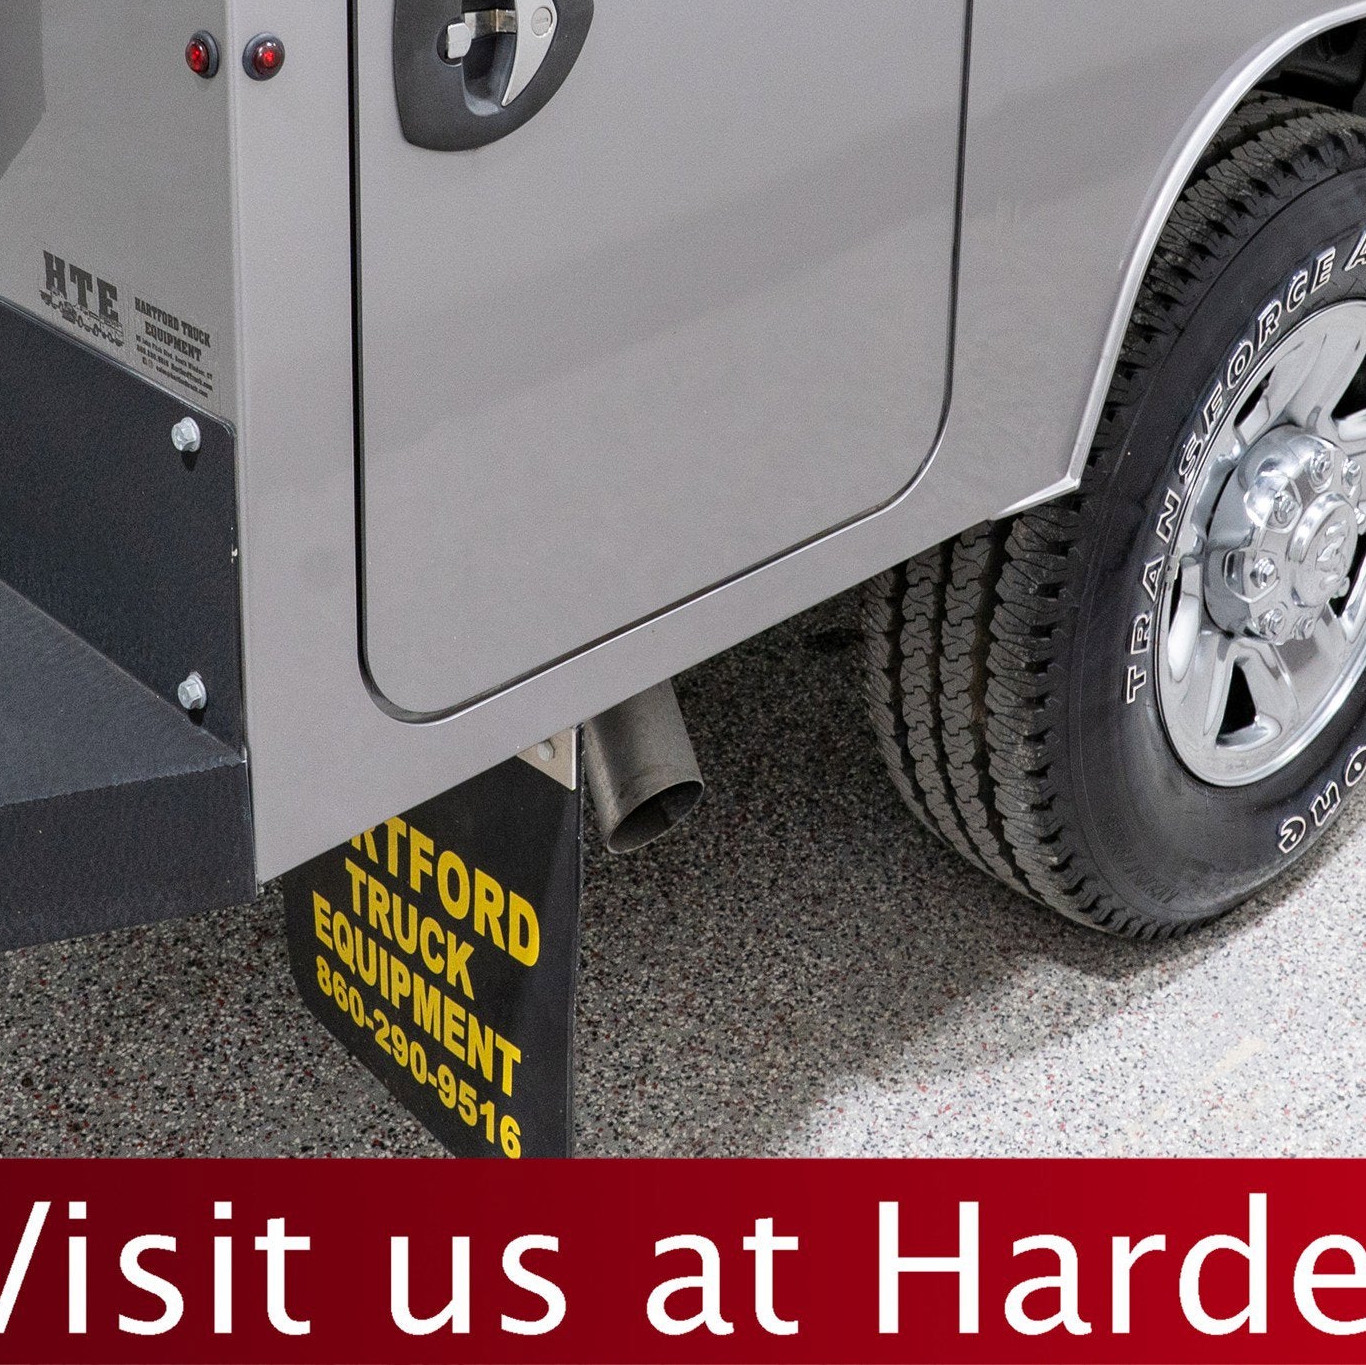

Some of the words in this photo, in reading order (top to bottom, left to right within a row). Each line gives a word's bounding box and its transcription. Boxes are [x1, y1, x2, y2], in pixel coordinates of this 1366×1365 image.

[43, 249, 120, 324] HTE
[135, 296, 180, 332] HARTFORD
[181, 320, 211, 349] TRUCK
[145, 320, 202, 363] EQUIPMENT
[1126, 246, 1336, 704] TRANSFORCE
[345, 857, 475, 1001] TRUCK
[350, 816, 540, 967] TFORD
[313, 890, 522, 1098] EQUIPMENT
[316, 955, 522, 1160] 860-290-9516
